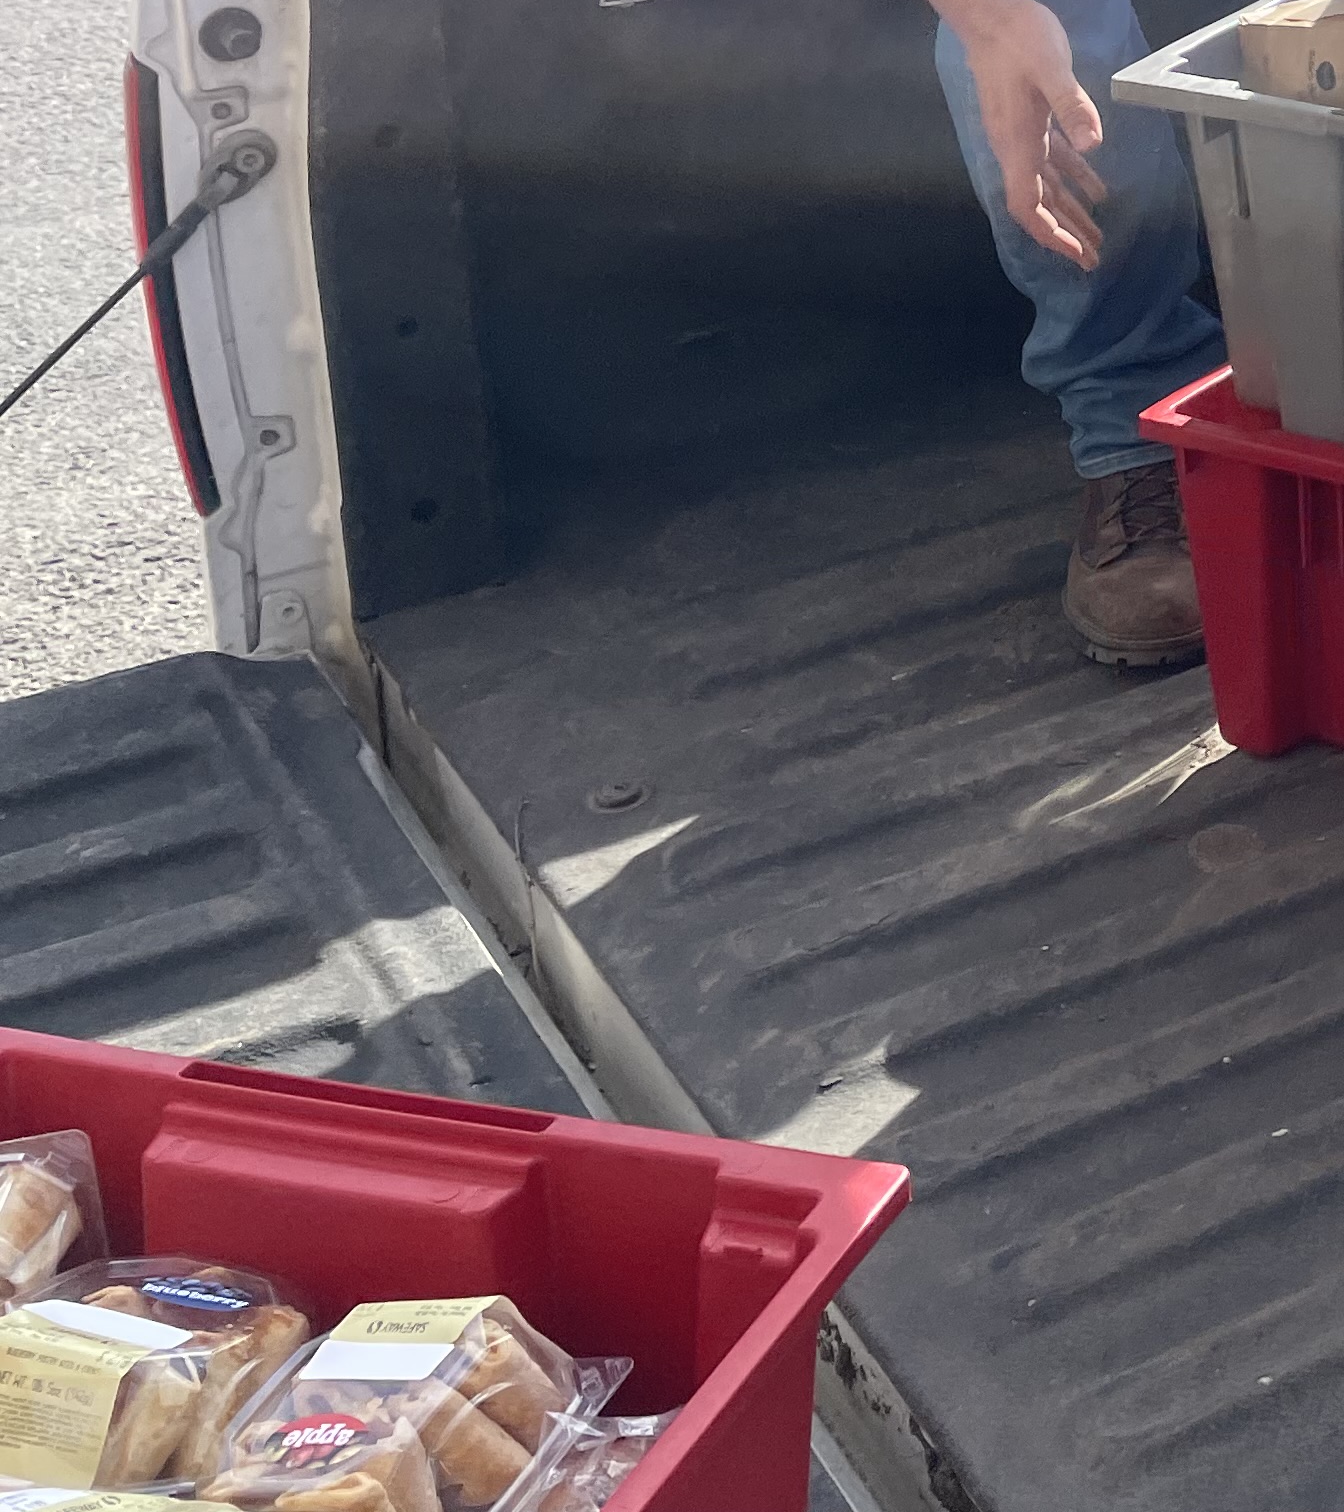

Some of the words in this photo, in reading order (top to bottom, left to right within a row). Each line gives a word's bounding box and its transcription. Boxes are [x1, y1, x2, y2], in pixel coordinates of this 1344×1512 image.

[142, 1282, 249, 1309] blueberry
[380, 1322, 430, 1334] SAFEWAY
[281, 1423, 355, 1448] apple
